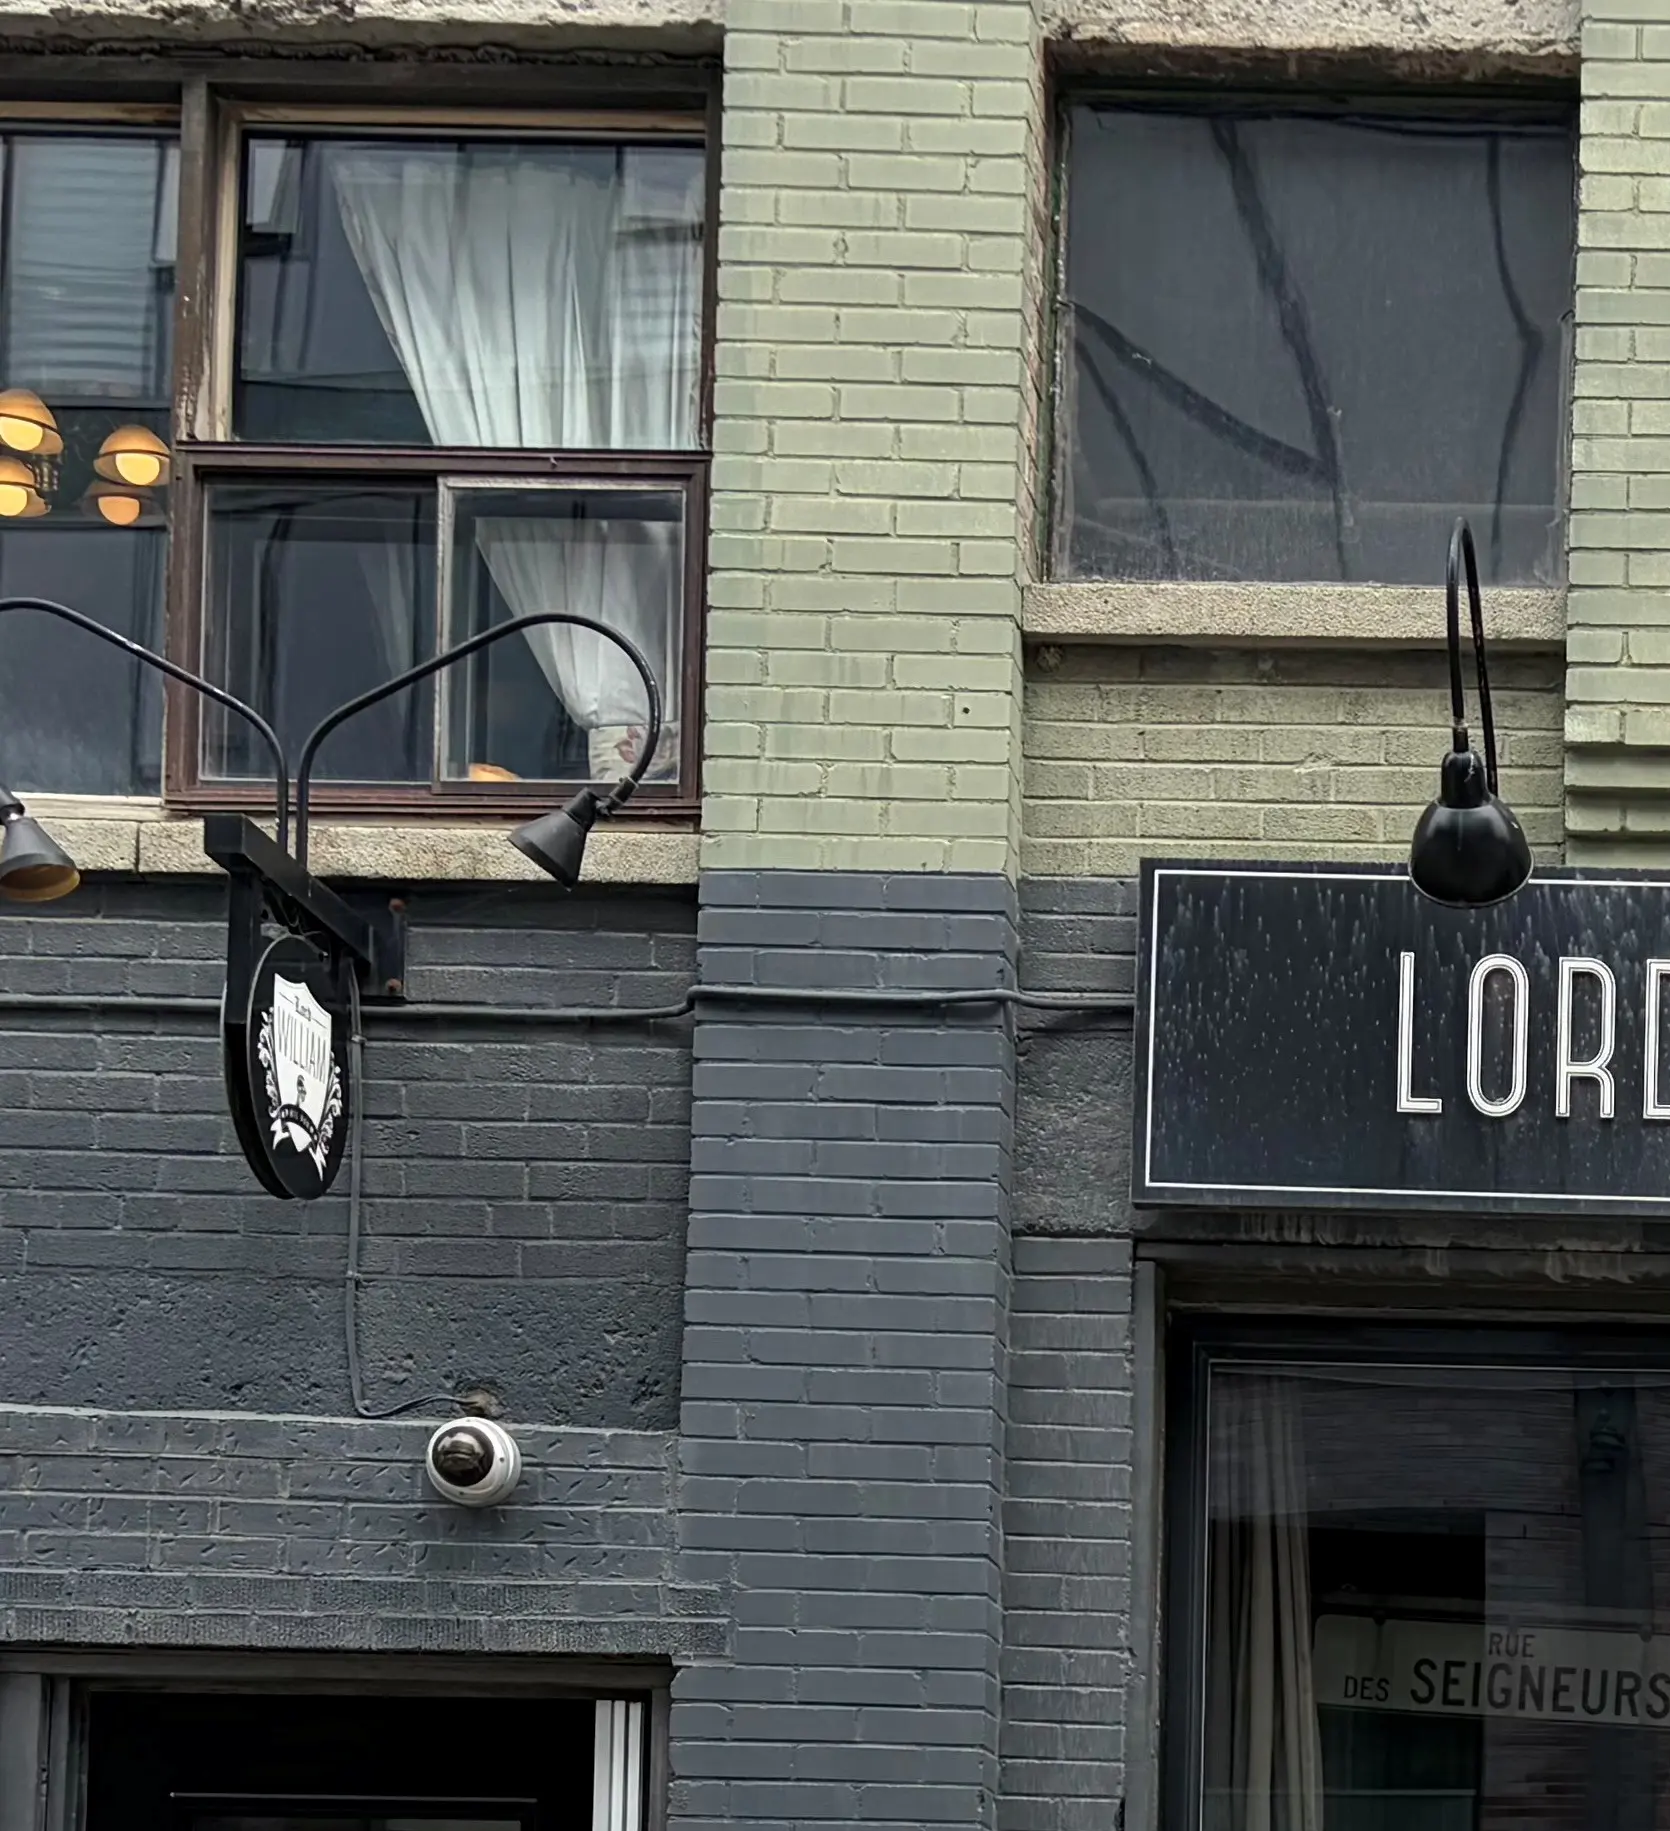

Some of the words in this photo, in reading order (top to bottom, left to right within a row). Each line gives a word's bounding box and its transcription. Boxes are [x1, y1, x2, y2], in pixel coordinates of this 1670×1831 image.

[277, 1005, 327, 1085] WILLIAM
[1488, 1632, 1536, 1659] RUE
[1343, 1675, 1390, 1702] DES
